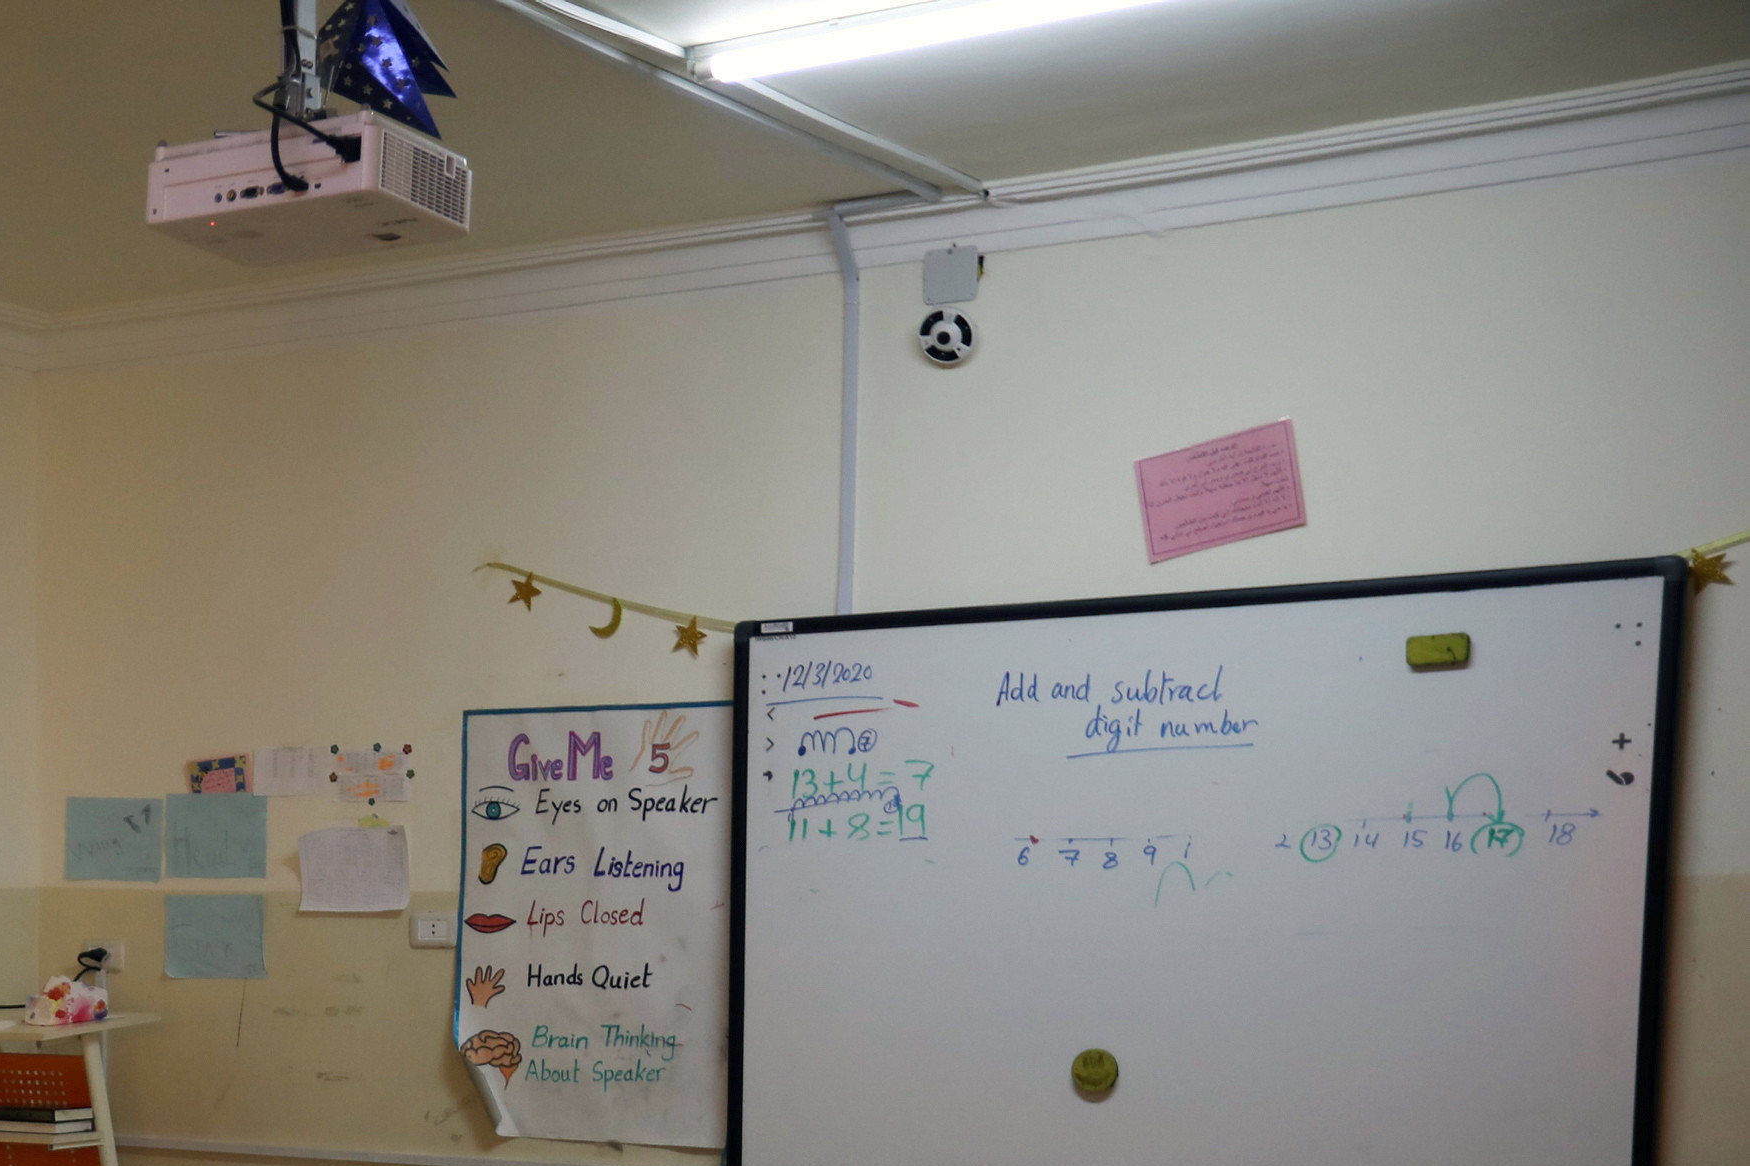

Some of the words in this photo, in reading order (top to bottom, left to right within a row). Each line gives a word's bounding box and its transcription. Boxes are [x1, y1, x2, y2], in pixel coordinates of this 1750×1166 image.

[996, 671, 1039, 707] Add
[1051, 673, 1090, 703] and
[1085, 704, 1142, 752] digit
[1160, 709, 1258, 739] number
[507, 732, 563, 782] Give
[566, 730, 614, 782] Me
[648, 742, 671, 774] 5
[535, 788, 582, 825] Eyes
[597, 796, 618, 813] on
[628, 784, 719, 821] Speaker
[1353, 830, 1381, 848] 14
[1403, 829, 1428, 848] 15
[1445, 830, 1472, 852] 16
[1549, 822, 1577, 846] 18
[520, 846, 576, 876] Ears
[594, 847, 685, 892] Listening
[1017, 846, 1030, 866] 6
[1102, 852, 1119, 869] 8
[1143, 845, 1157, 865] 9
[526, 900, 565, 938] Lips
[581, 898, 645, 926] Closed
[527, 963, 584, 988] Hands
[592, 962, 654, 990] Quiet
[531, 1025, 590, 1050] Brain
[601, 1024, 677, 1062] Thinking
[525, 1058, 581, 1083] About
[592, 1058, 668, 1092] Speaker
